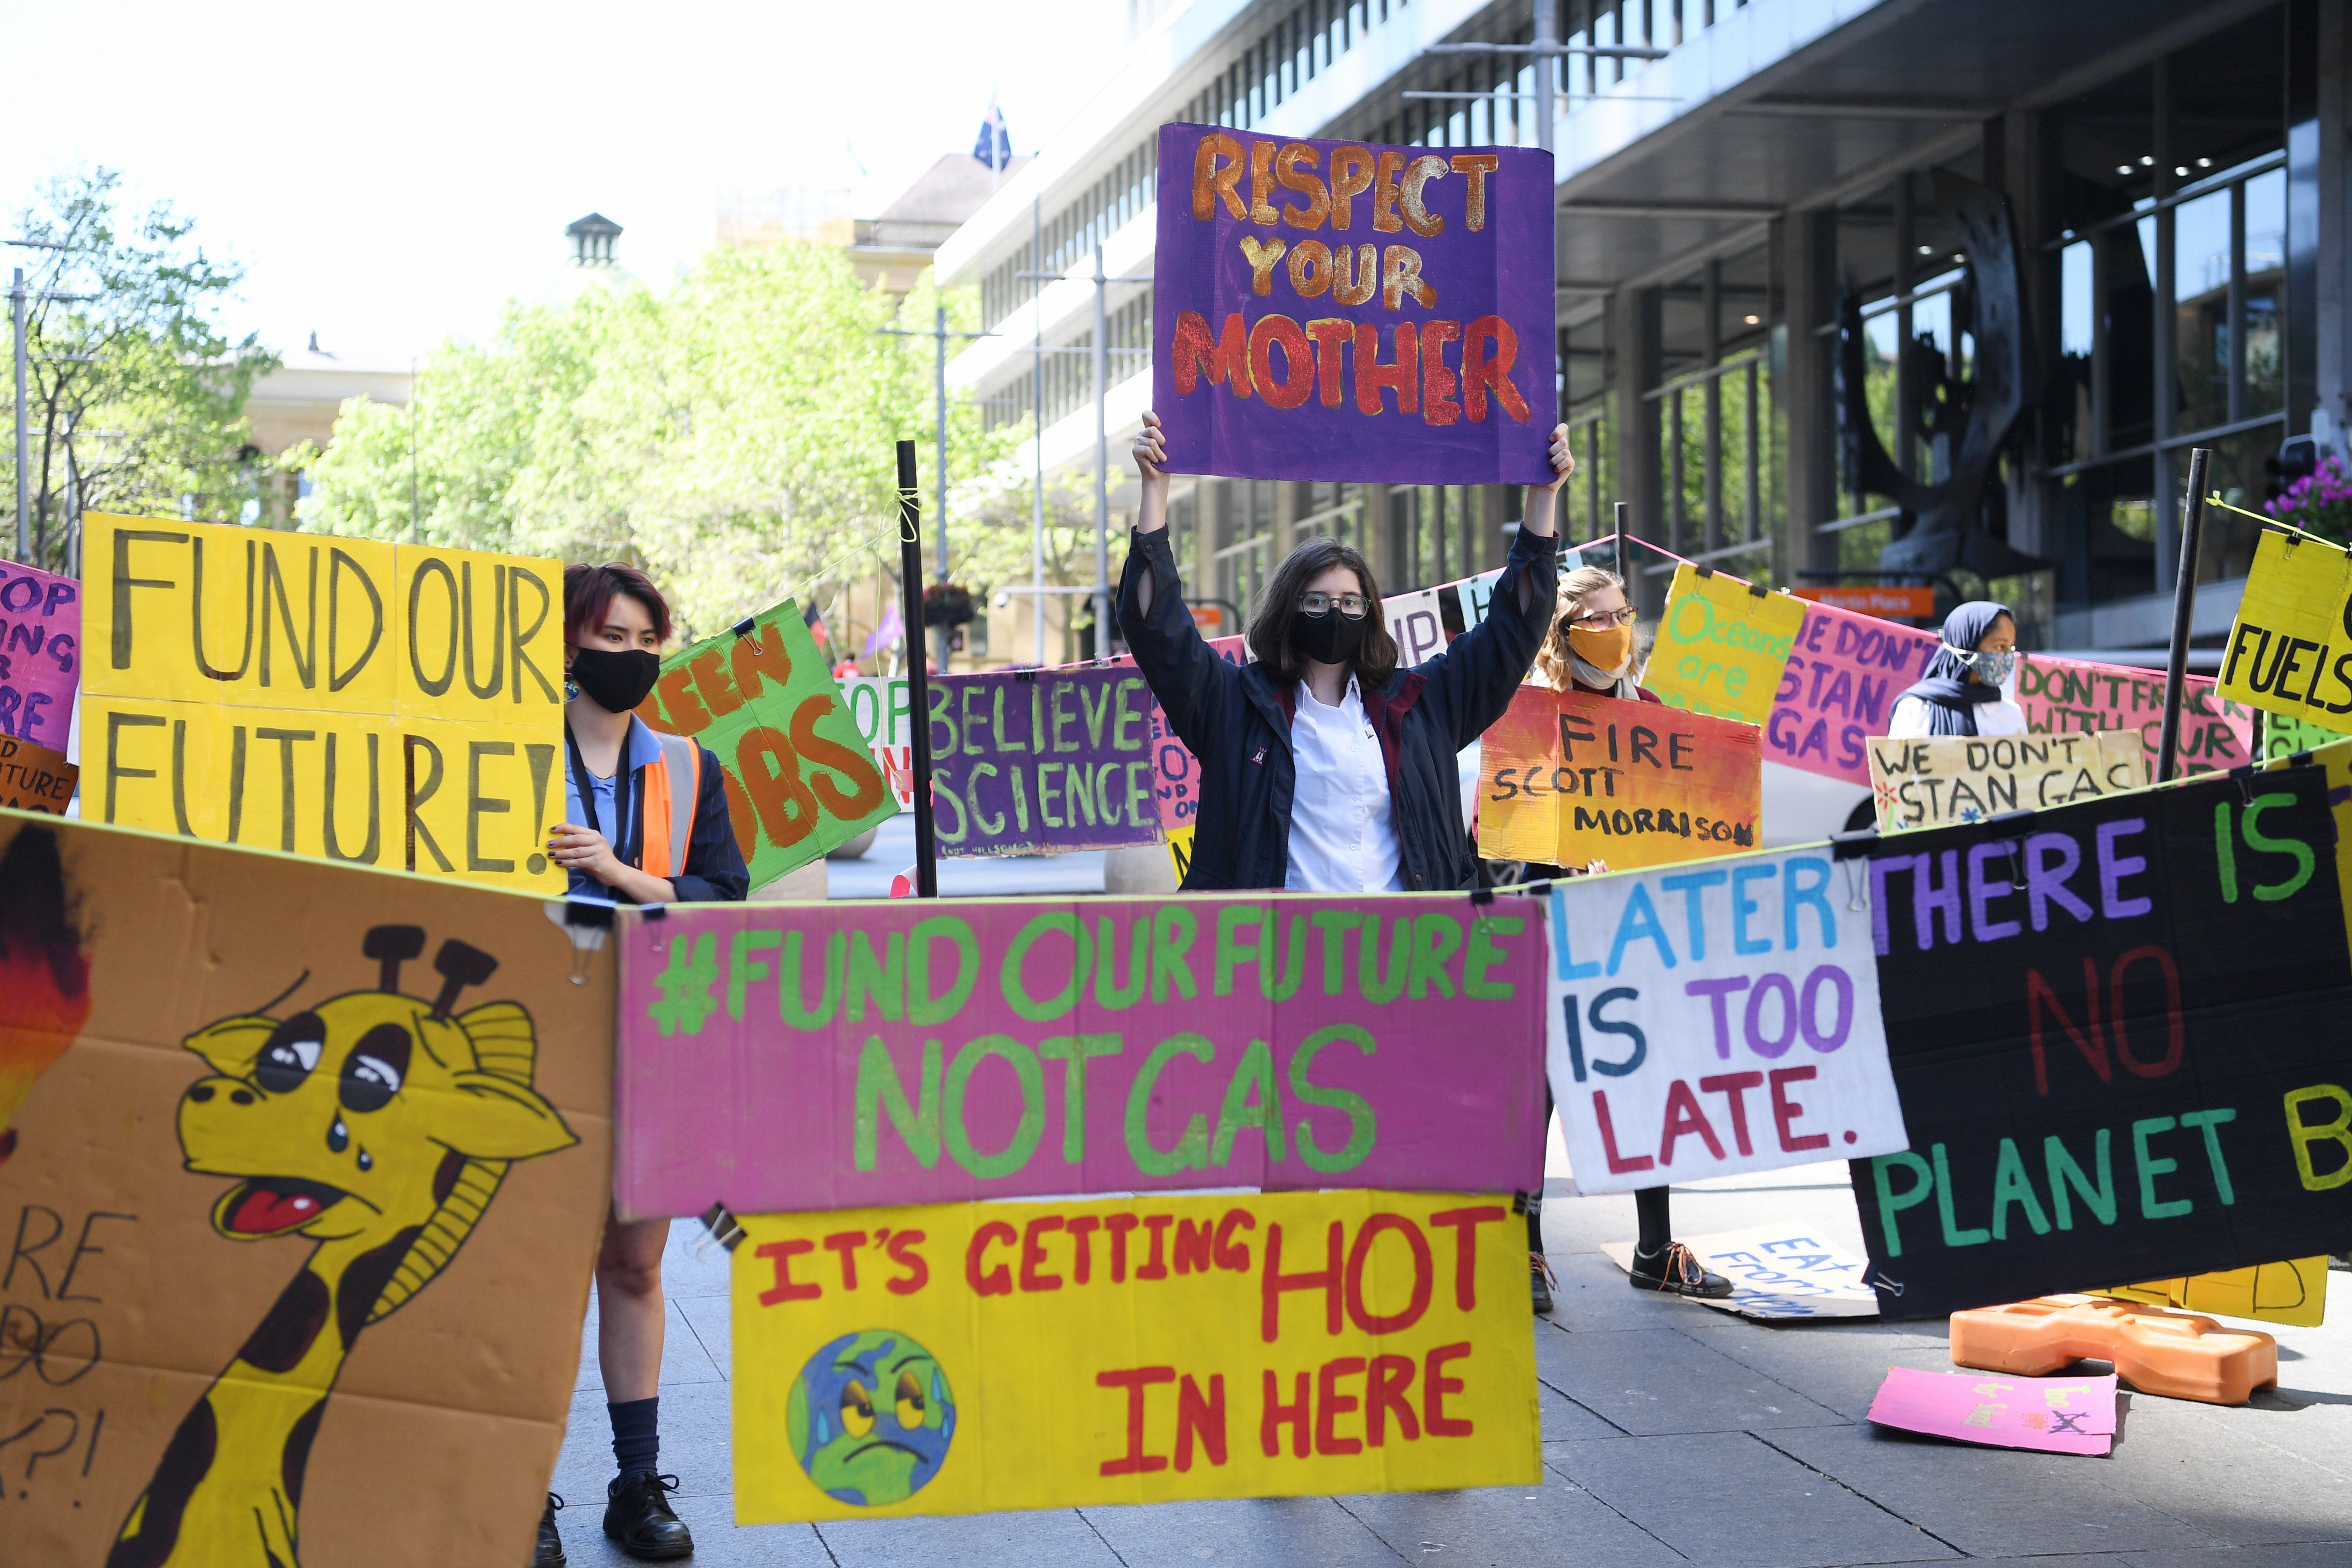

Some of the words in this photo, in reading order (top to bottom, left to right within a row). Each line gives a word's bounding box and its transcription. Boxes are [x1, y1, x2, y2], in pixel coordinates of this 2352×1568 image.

[1192, 133, 1498, 237] RESPECT
[1239, 234, 1437, 311] YOUR
[1172, 309, 1532, 426] MOTHER
[0, 569, 76, 616] OP
[111, 528, 383, 692] FUND
[408, 557, 560, 705] OUR
[1669, 593, 1794, 662] Oceans
[1678, 655, 1748, 698] are
[1775, 656, 1888, 726] STAN
[2019, 662, 2130, 708] DON'T
[2224, 623, 2352, 714] FUELS
[836, 681, 910, 745] OP
[928, 677, 1144, 760] BELIEVE
[1559, 713, 1695, 771] FIRE
[1769, 708, 1867, 770] GAS
[0, 763, 70, 800] TURE
[106, 711, 555, 876] FUTURE!
[1492, 766, 1625, 801] SCOTT
[1875, 744, 1932, 776] WE
[1967, 738, 2080, 771] DON'T
[1899, 773, 2018, 822] STAN
[932, 761, 1155, 844] SCIENCE
[1574, 805, 1754, 847] MORRISON
[1869, 817, 2152, 956] THERE
[2214, 792, 2315, 904] IS
[1550, 856, 1838, 982] LATER
[648, 915, 980, 1037] #FUND
[999, 904, 1198, 1022] OUR
[1214, 904, 1525, 1004] FUTURE
[1563, 987, 1647, 1083] IS
[1685, 964, 1854, 1060] TOO
[2026, 945, 2186, 1098] NO
[854, 1032, 1123, 1180] NOT
[1124, 1023, 1377, 1177] GAS
[1593, 1064, 1857, 1175] LATE.
[1871, 1108, 2237, 1258] PLANET
[2283, 1083, 2352, 1192] B
[2, 1205, 139, 1304] RE
[754, 1227, 930, 1308] IT'S
[964, 1207, 1257, 1298] GETTING
[1261, 1205, 1507, 1344] HOT
[1095, 1364, 1228, 1477] IN
[1260, 1341, 1474, 1459] HERE
